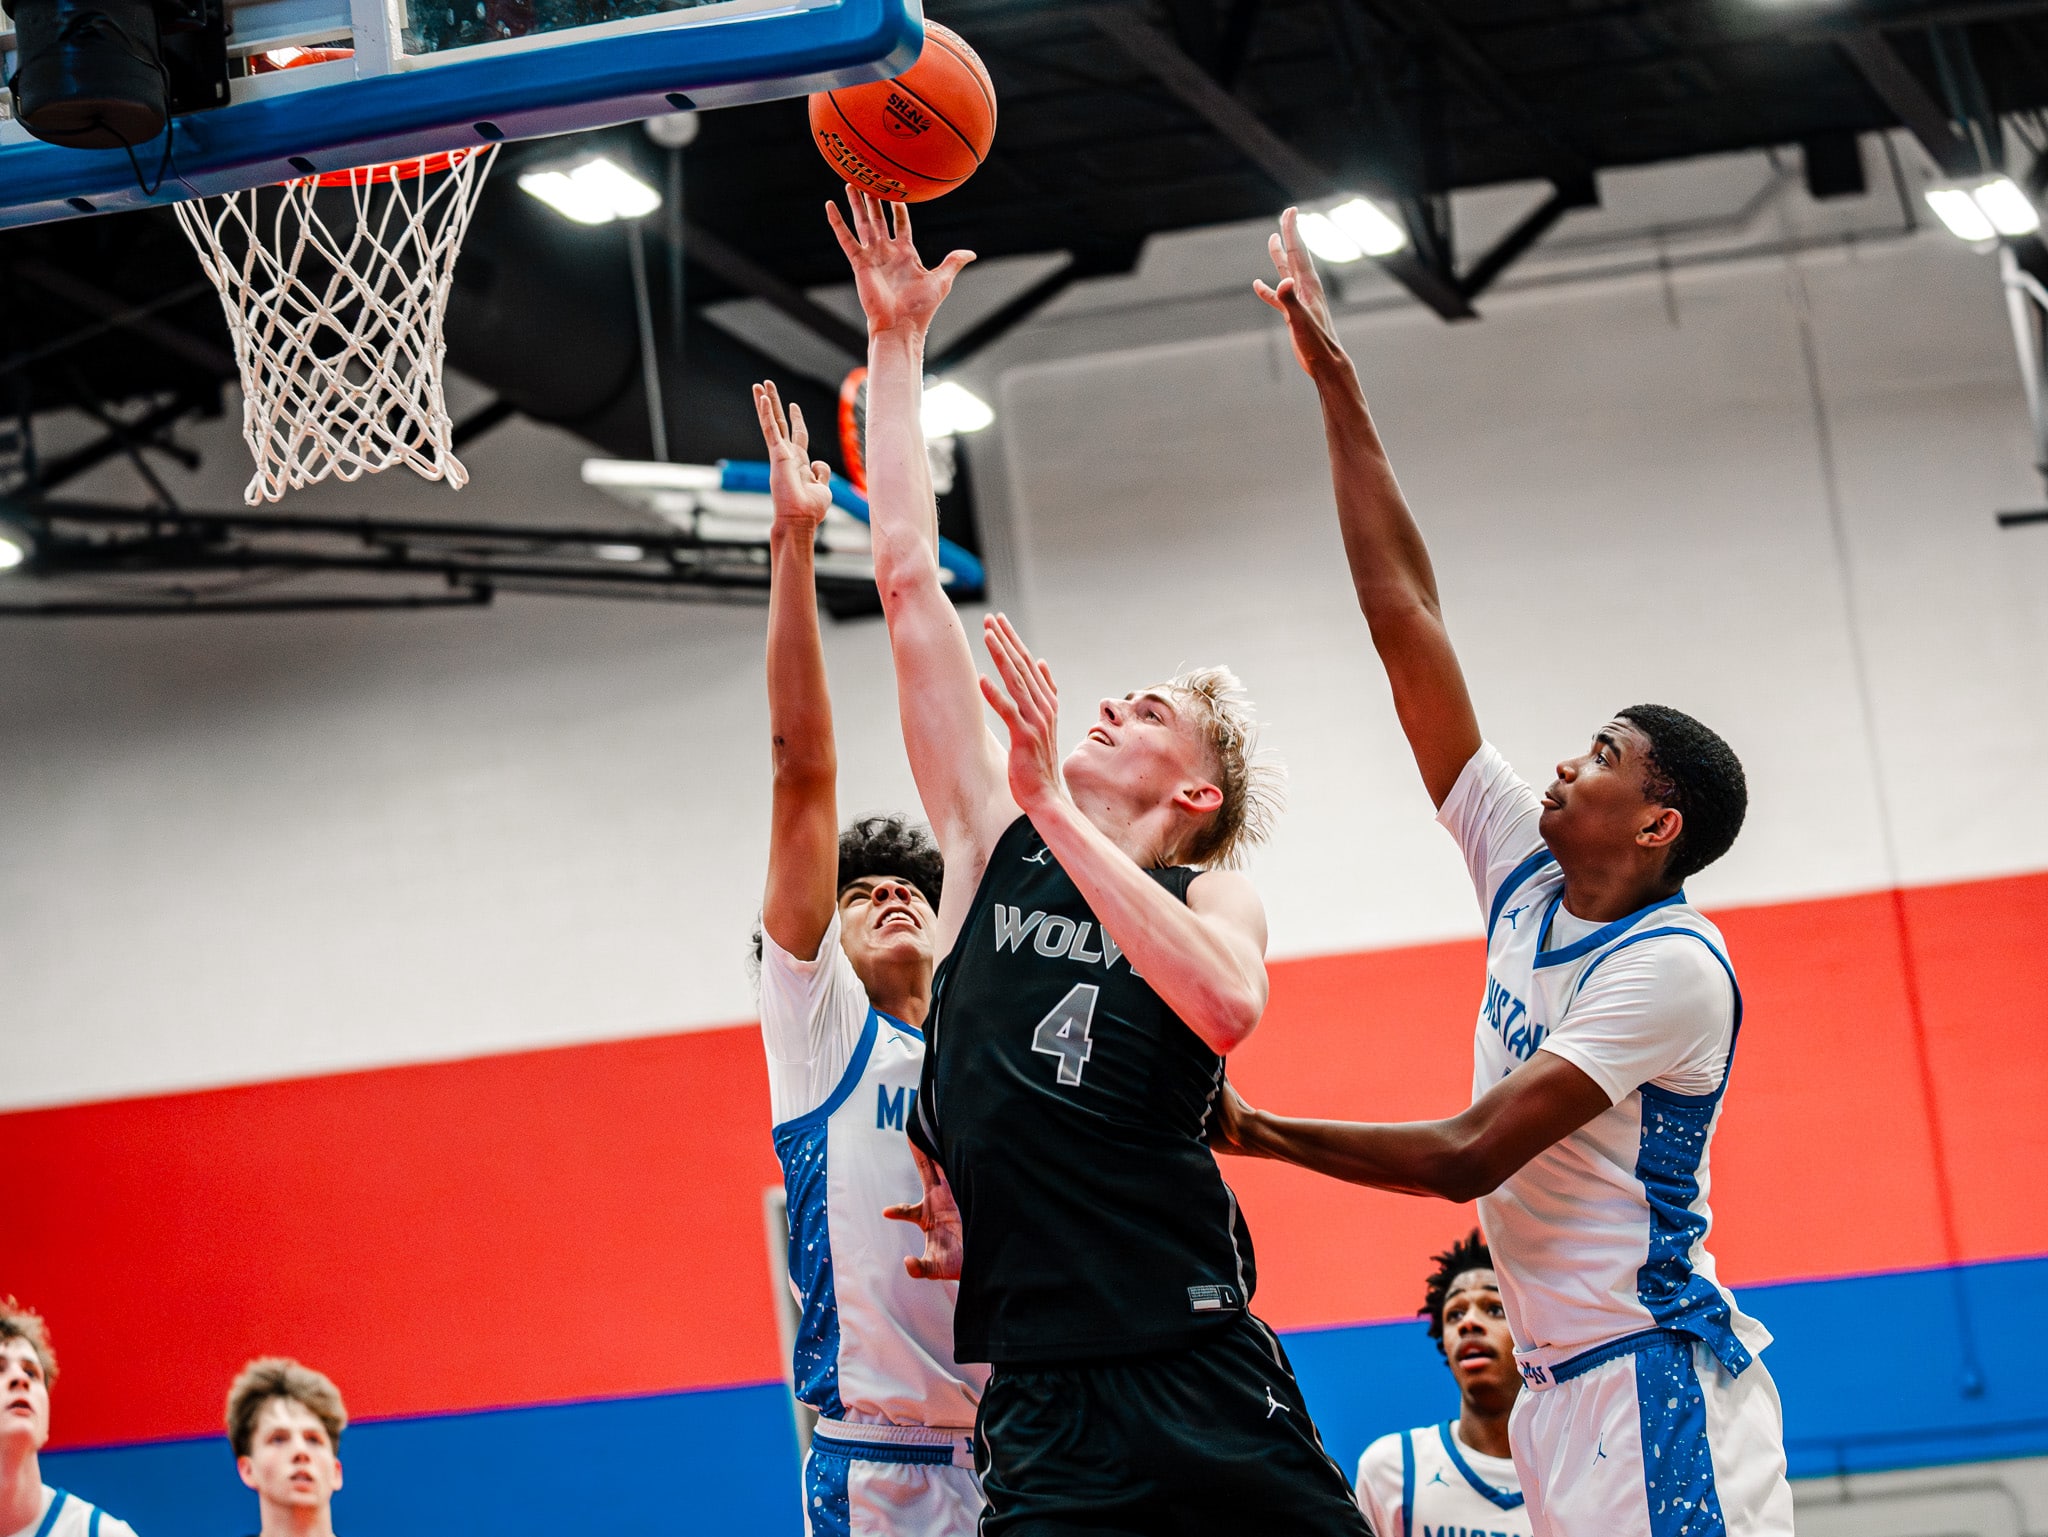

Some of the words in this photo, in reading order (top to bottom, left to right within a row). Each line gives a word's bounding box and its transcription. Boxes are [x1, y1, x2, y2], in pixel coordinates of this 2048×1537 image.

[888, 93, 923, 125] NFHS
[819, 129, 909, 198] LEGACY
[1031, 983, 1099, 1087] 4
[1225, 1291, 1233, 1303] L
